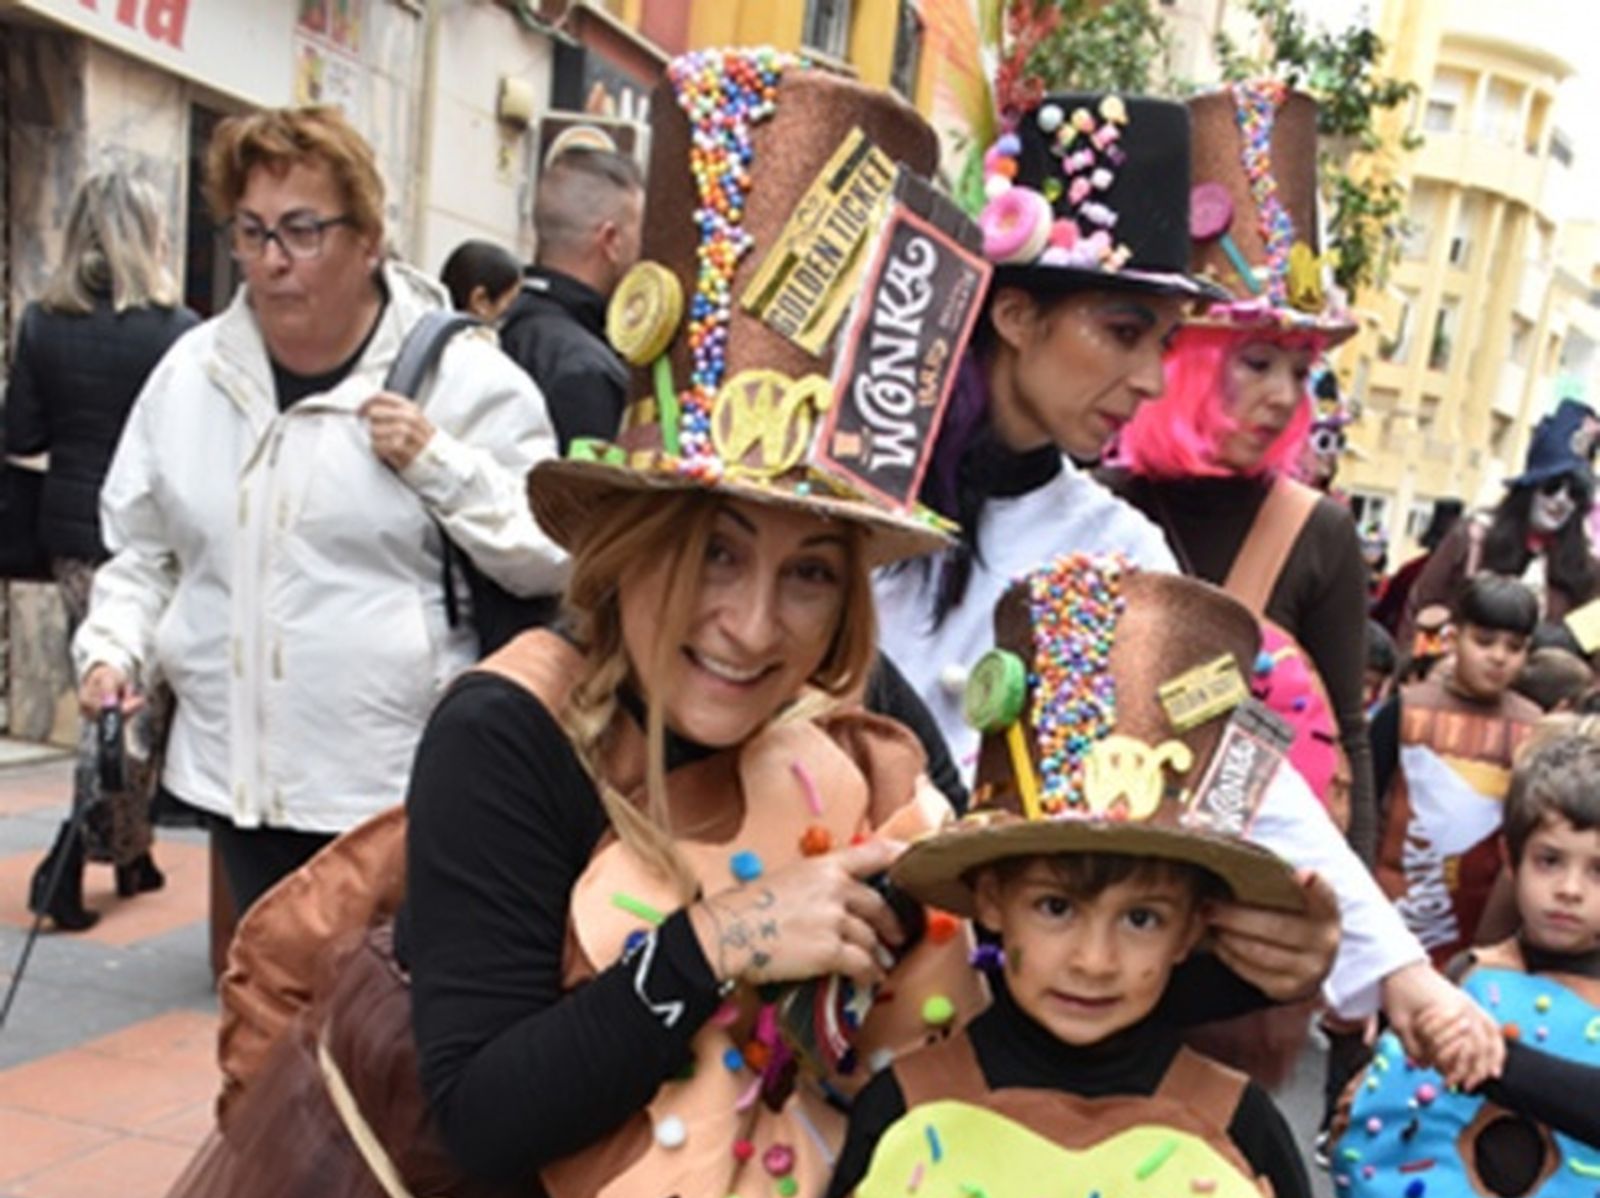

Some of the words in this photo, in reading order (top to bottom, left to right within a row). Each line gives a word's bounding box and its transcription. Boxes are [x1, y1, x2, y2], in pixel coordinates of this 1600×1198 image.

[766, 235, 844, 337] GOLDEN
[825, 153, 892, 242] TICKET
[854, 236, 938, 472] WONKA
